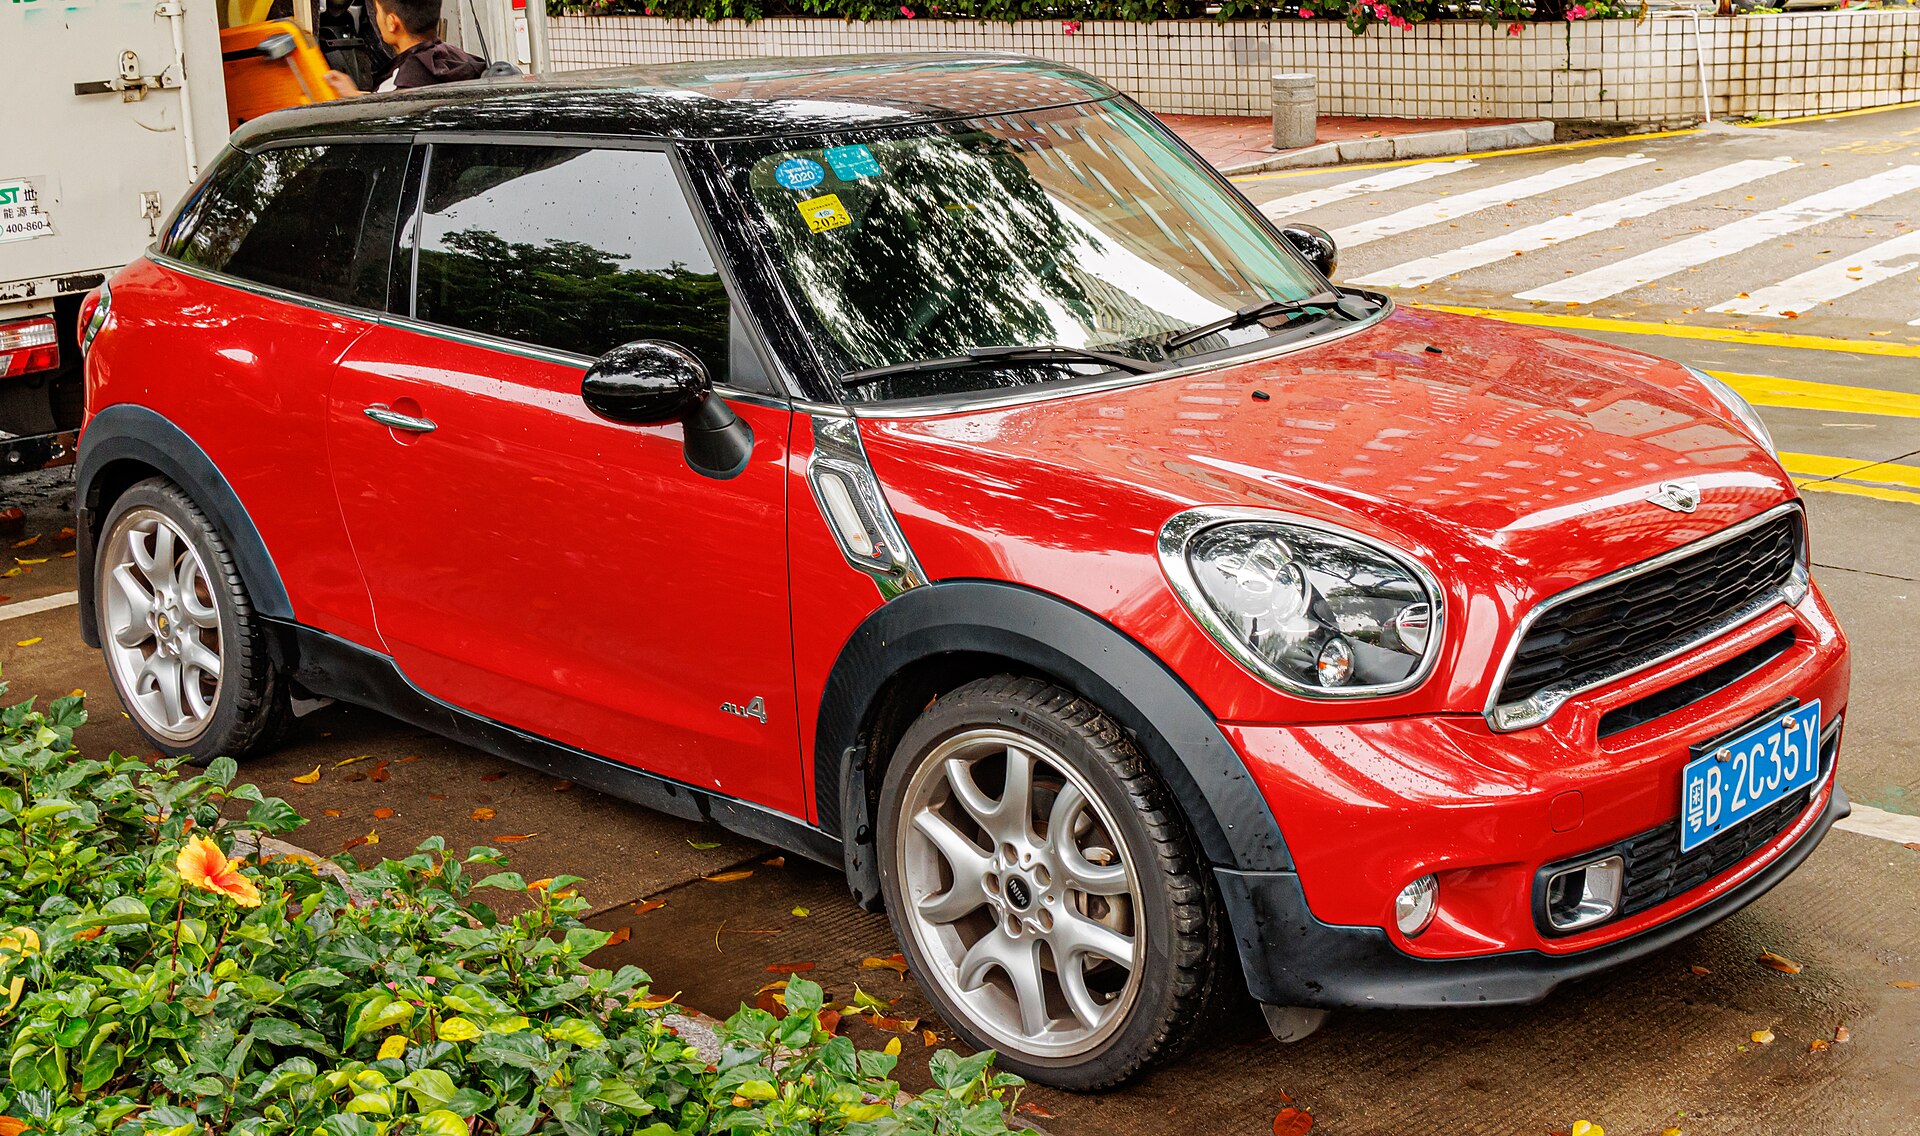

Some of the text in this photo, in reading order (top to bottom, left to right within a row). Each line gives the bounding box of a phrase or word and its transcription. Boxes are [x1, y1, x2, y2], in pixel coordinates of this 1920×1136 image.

[789, 170, 815, 184] 2020
[812, 214, 847, 231] 2023
[1009, 879, 1028, 906] MINI
